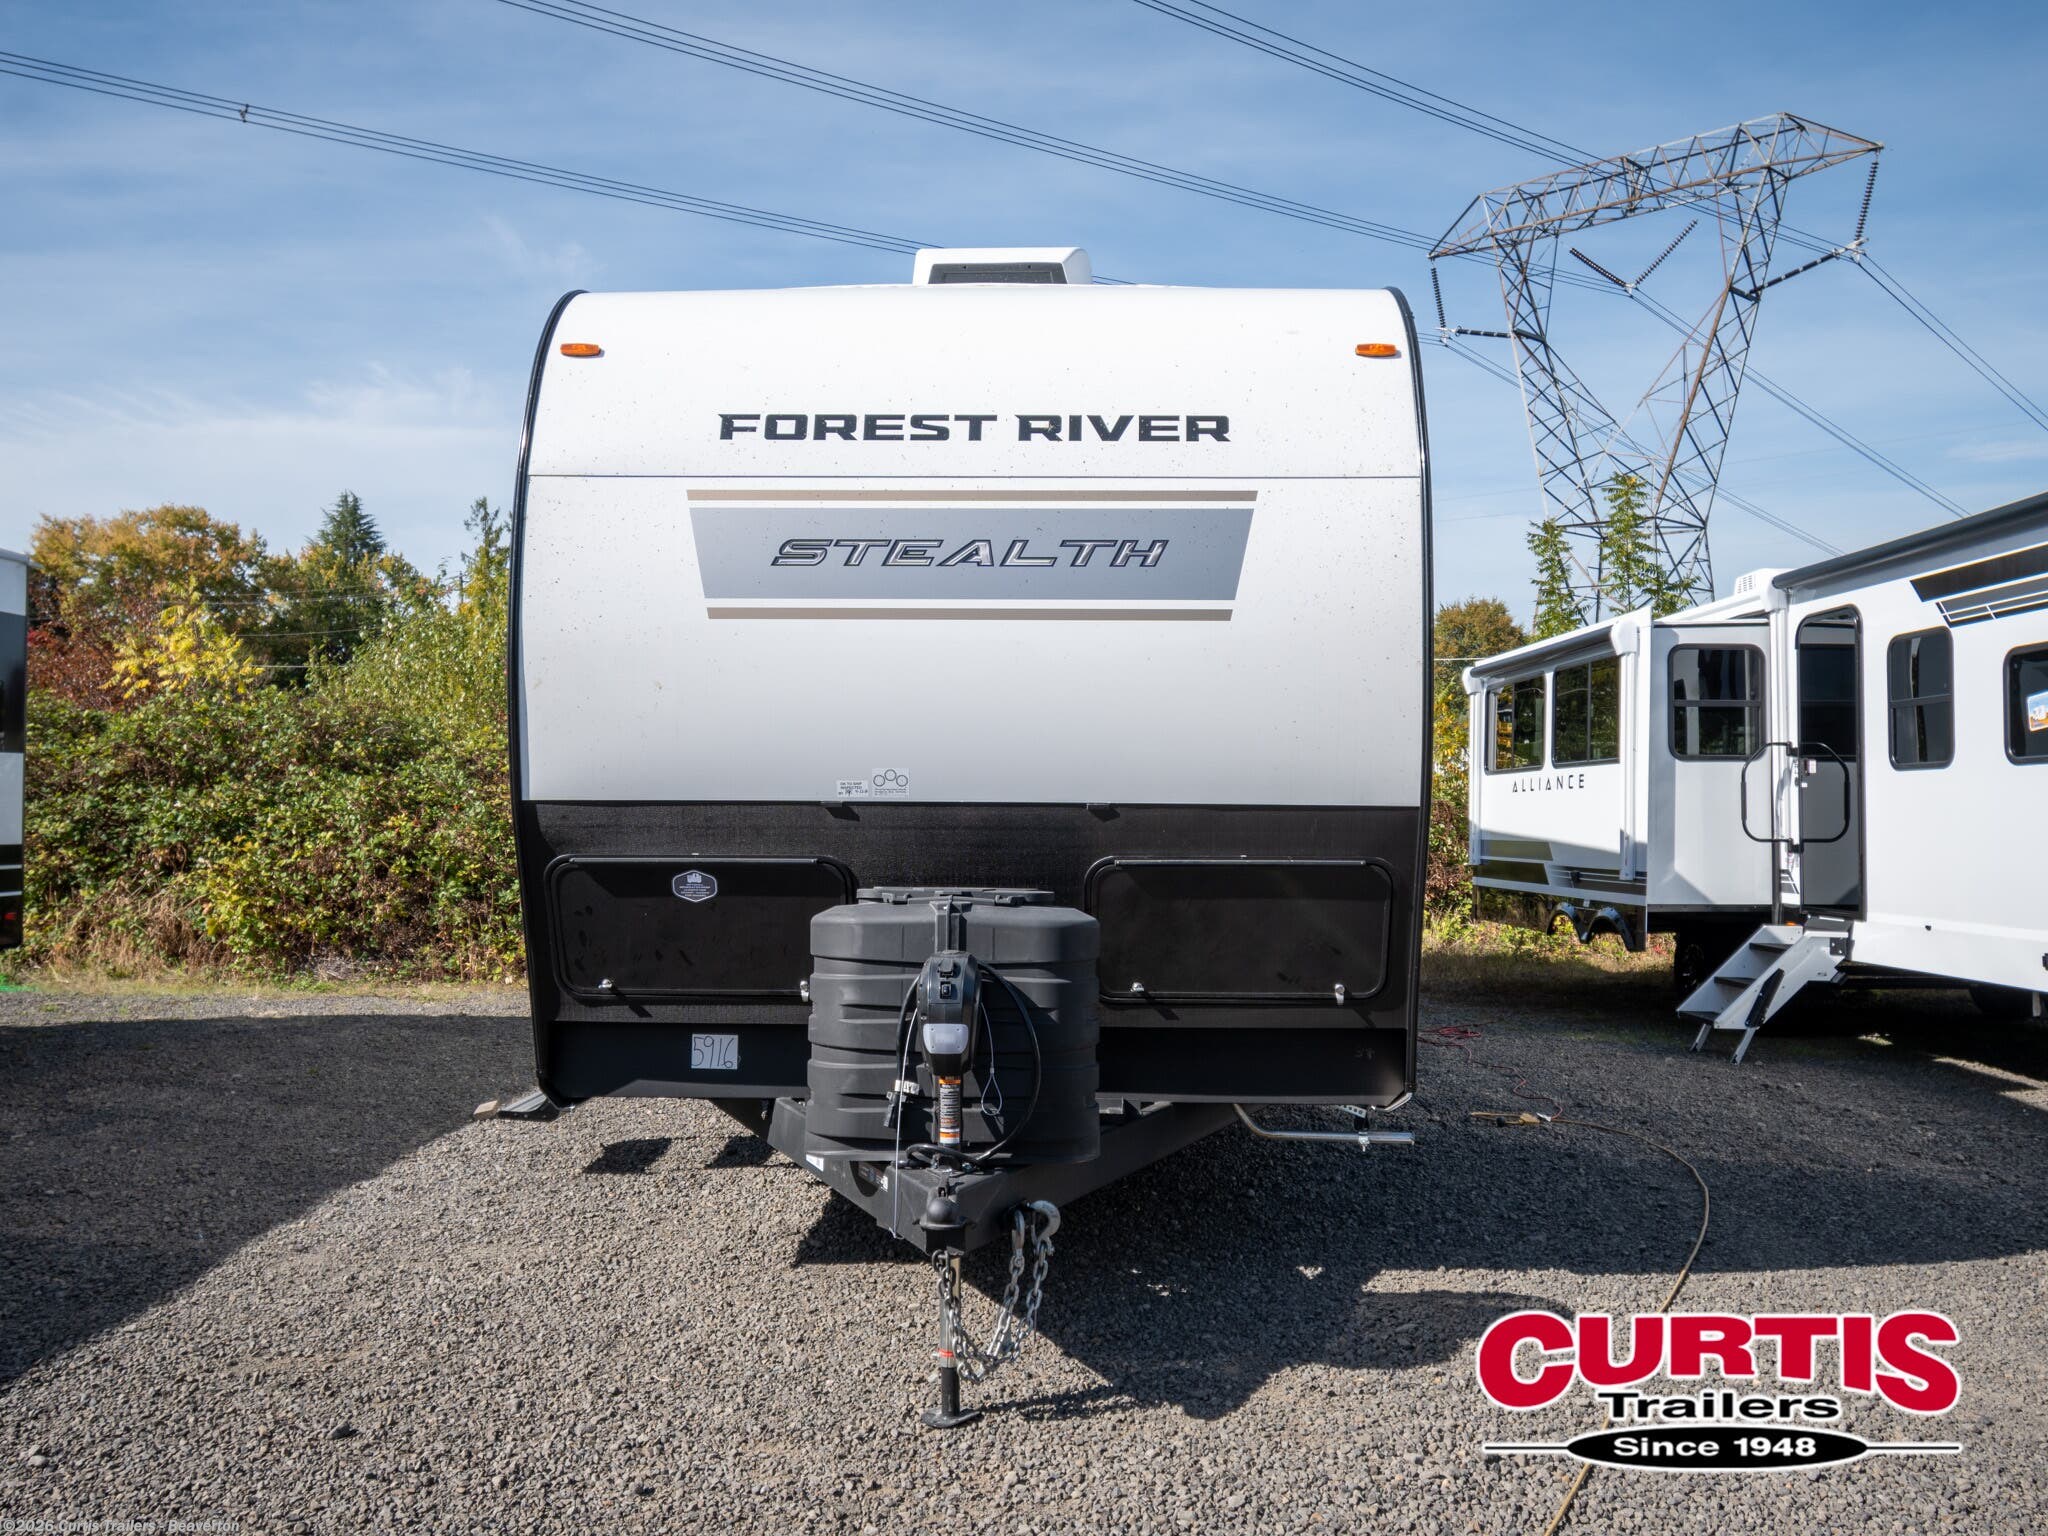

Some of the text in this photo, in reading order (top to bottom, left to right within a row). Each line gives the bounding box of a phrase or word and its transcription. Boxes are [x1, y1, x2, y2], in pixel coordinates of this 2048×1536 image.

[718, 413, 1231, 442] FOREST RIVER
[770, 538, 1170, 568] STEALTH
[1513, 774, 1585, 793] ALLIANCE
[692, 1036, 735, 1069] 5916
